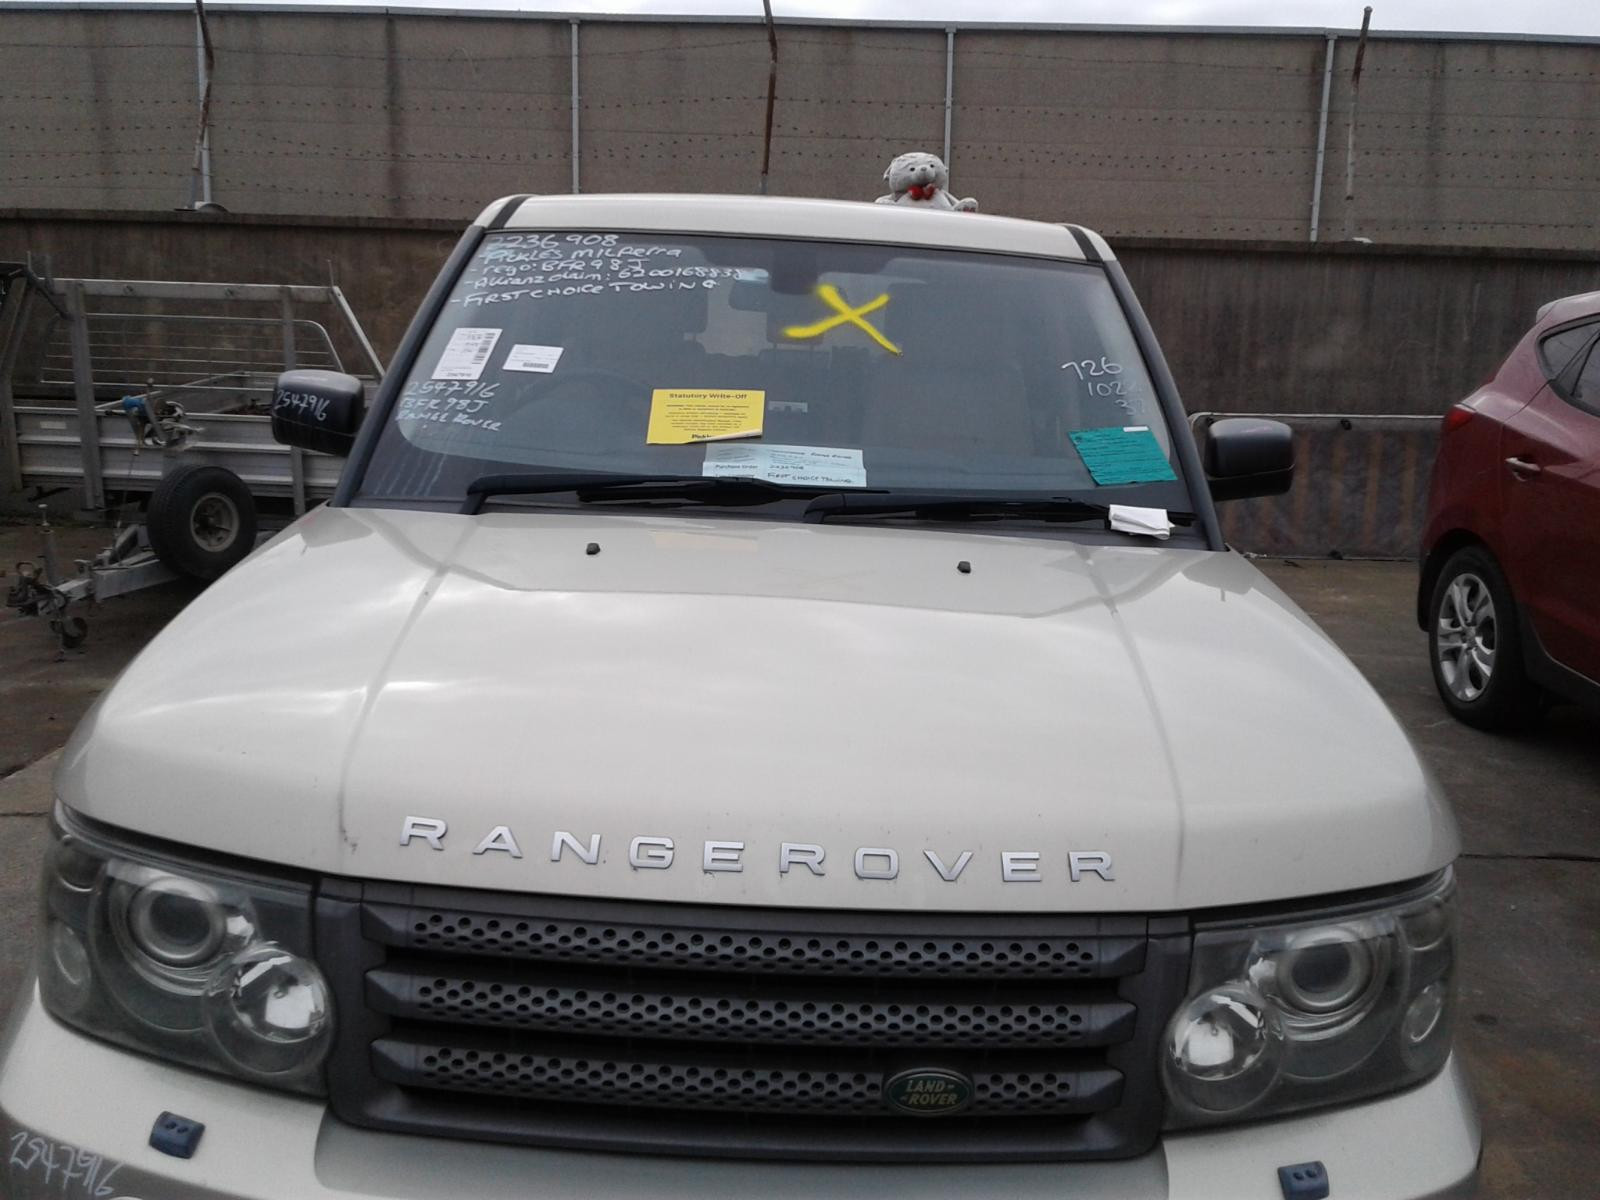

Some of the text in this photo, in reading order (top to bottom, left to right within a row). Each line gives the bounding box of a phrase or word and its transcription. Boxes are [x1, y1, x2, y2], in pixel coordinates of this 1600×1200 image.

[565, 233, 619, 247] 908
[541, 259, 585, 272] BFR
[1061, 356, 1123, 380] 726
[403, 380, 501, 397] 2547916
[273, 388, 331, 421] 2547916
[444, 397, 489, 413] 98J
[399, 814, 1118, 883] RANGE ROVER
[905, 1079, 946, 1093] LAND
[908, 1093, 958, 1105] ROVER
[9, 1131, 125, 1196] 2547916
